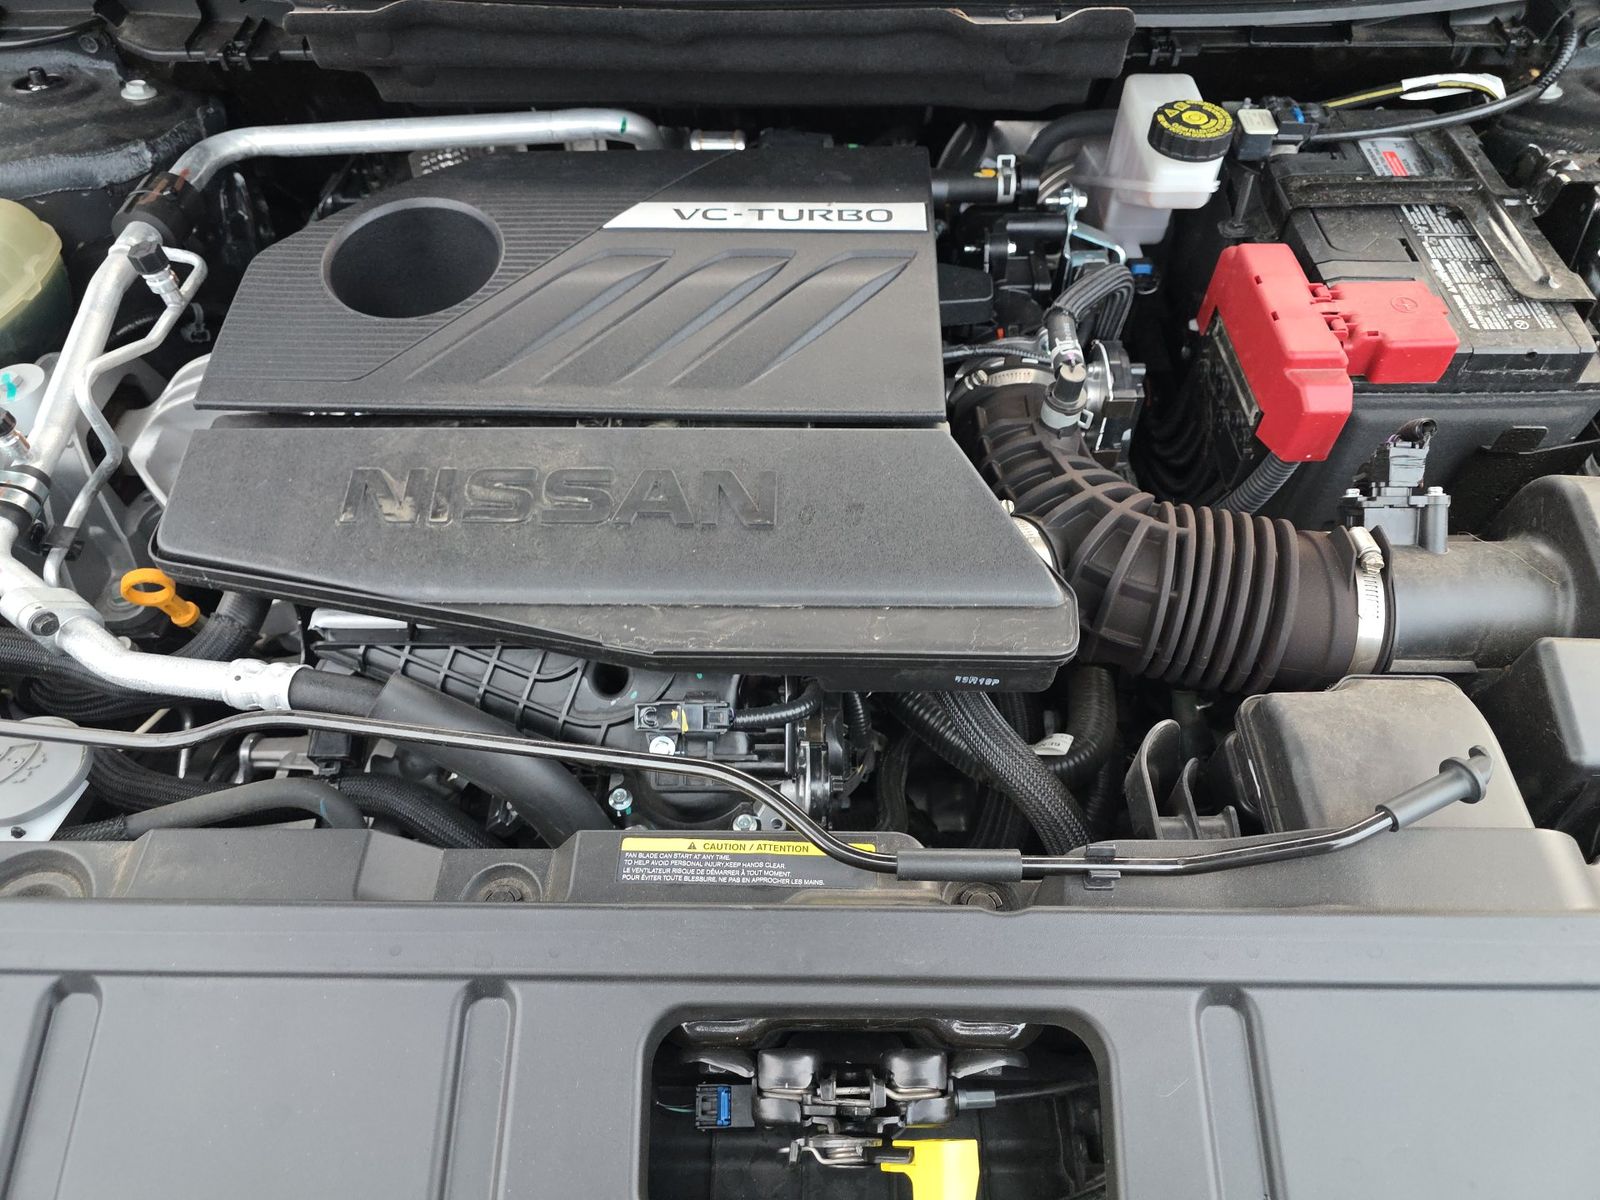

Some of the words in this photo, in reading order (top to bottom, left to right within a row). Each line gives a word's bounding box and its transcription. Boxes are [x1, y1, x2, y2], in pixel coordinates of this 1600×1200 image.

[673, 208, 894, 222] VC-TURBO
[336, 467, 778, 529] NISSAN
[703, 842, 746, 851] CAUTION
[757, 844, 809, 853] ATTENTION
